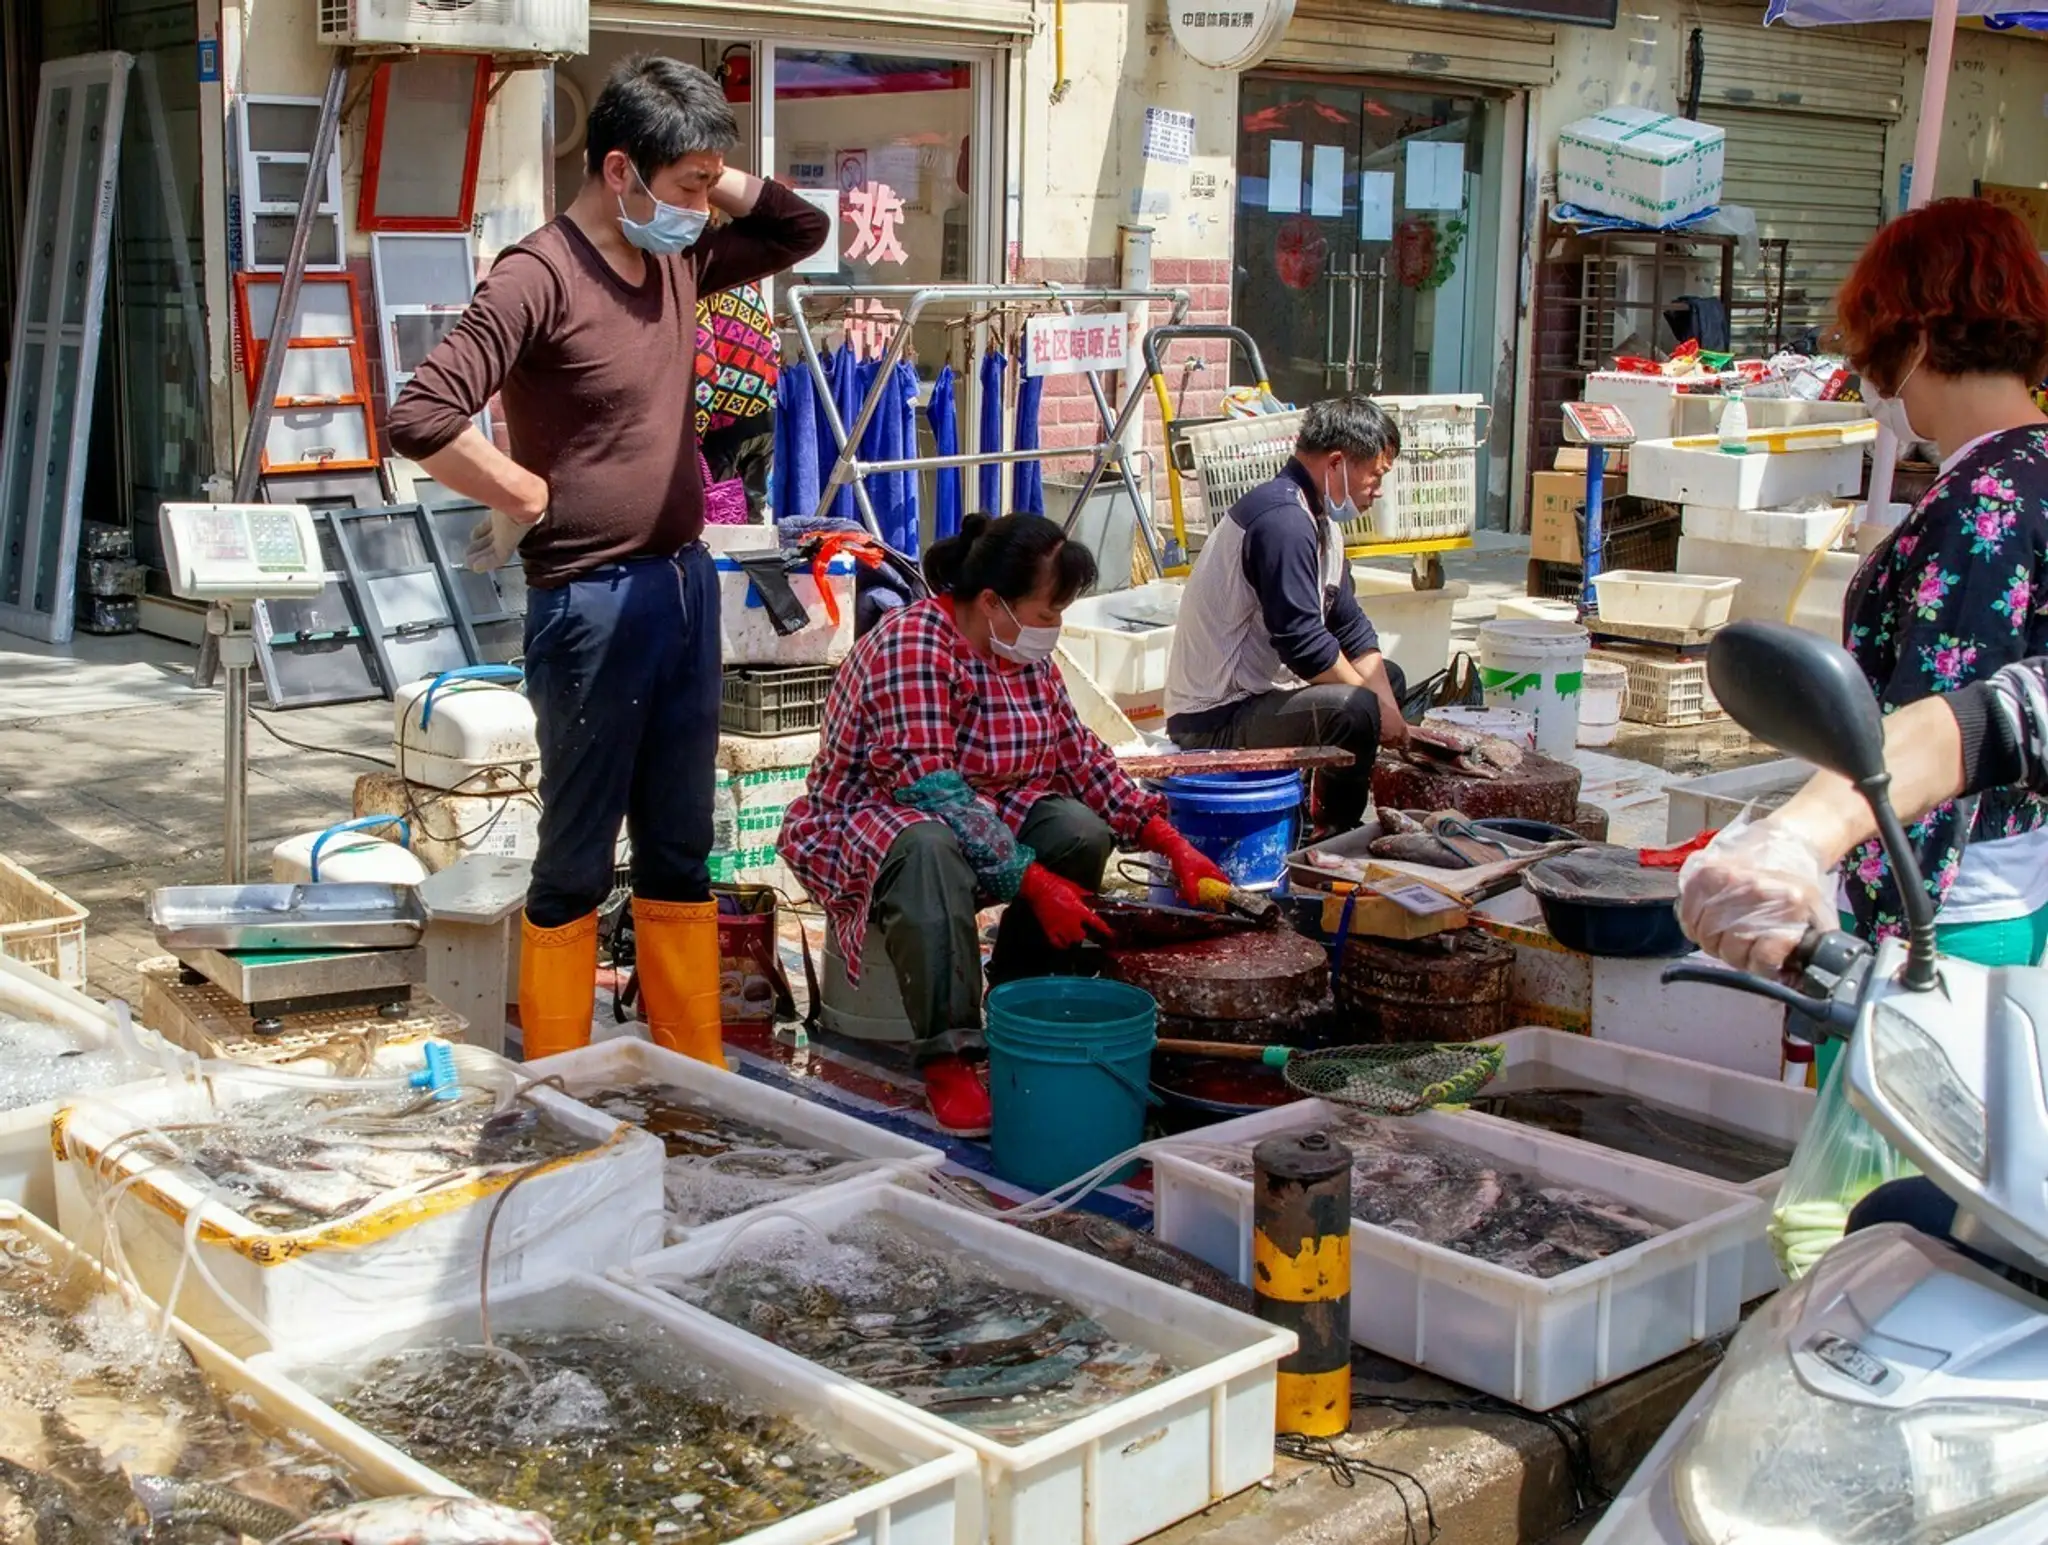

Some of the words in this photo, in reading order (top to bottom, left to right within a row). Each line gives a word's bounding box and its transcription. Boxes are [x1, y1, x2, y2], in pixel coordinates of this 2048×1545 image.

[1182, 11, 1254, 28] 中国体育彩票
[845, 181, 909, 266] 欢
[1033, 324, 1122, 363] 社区晾晒点
